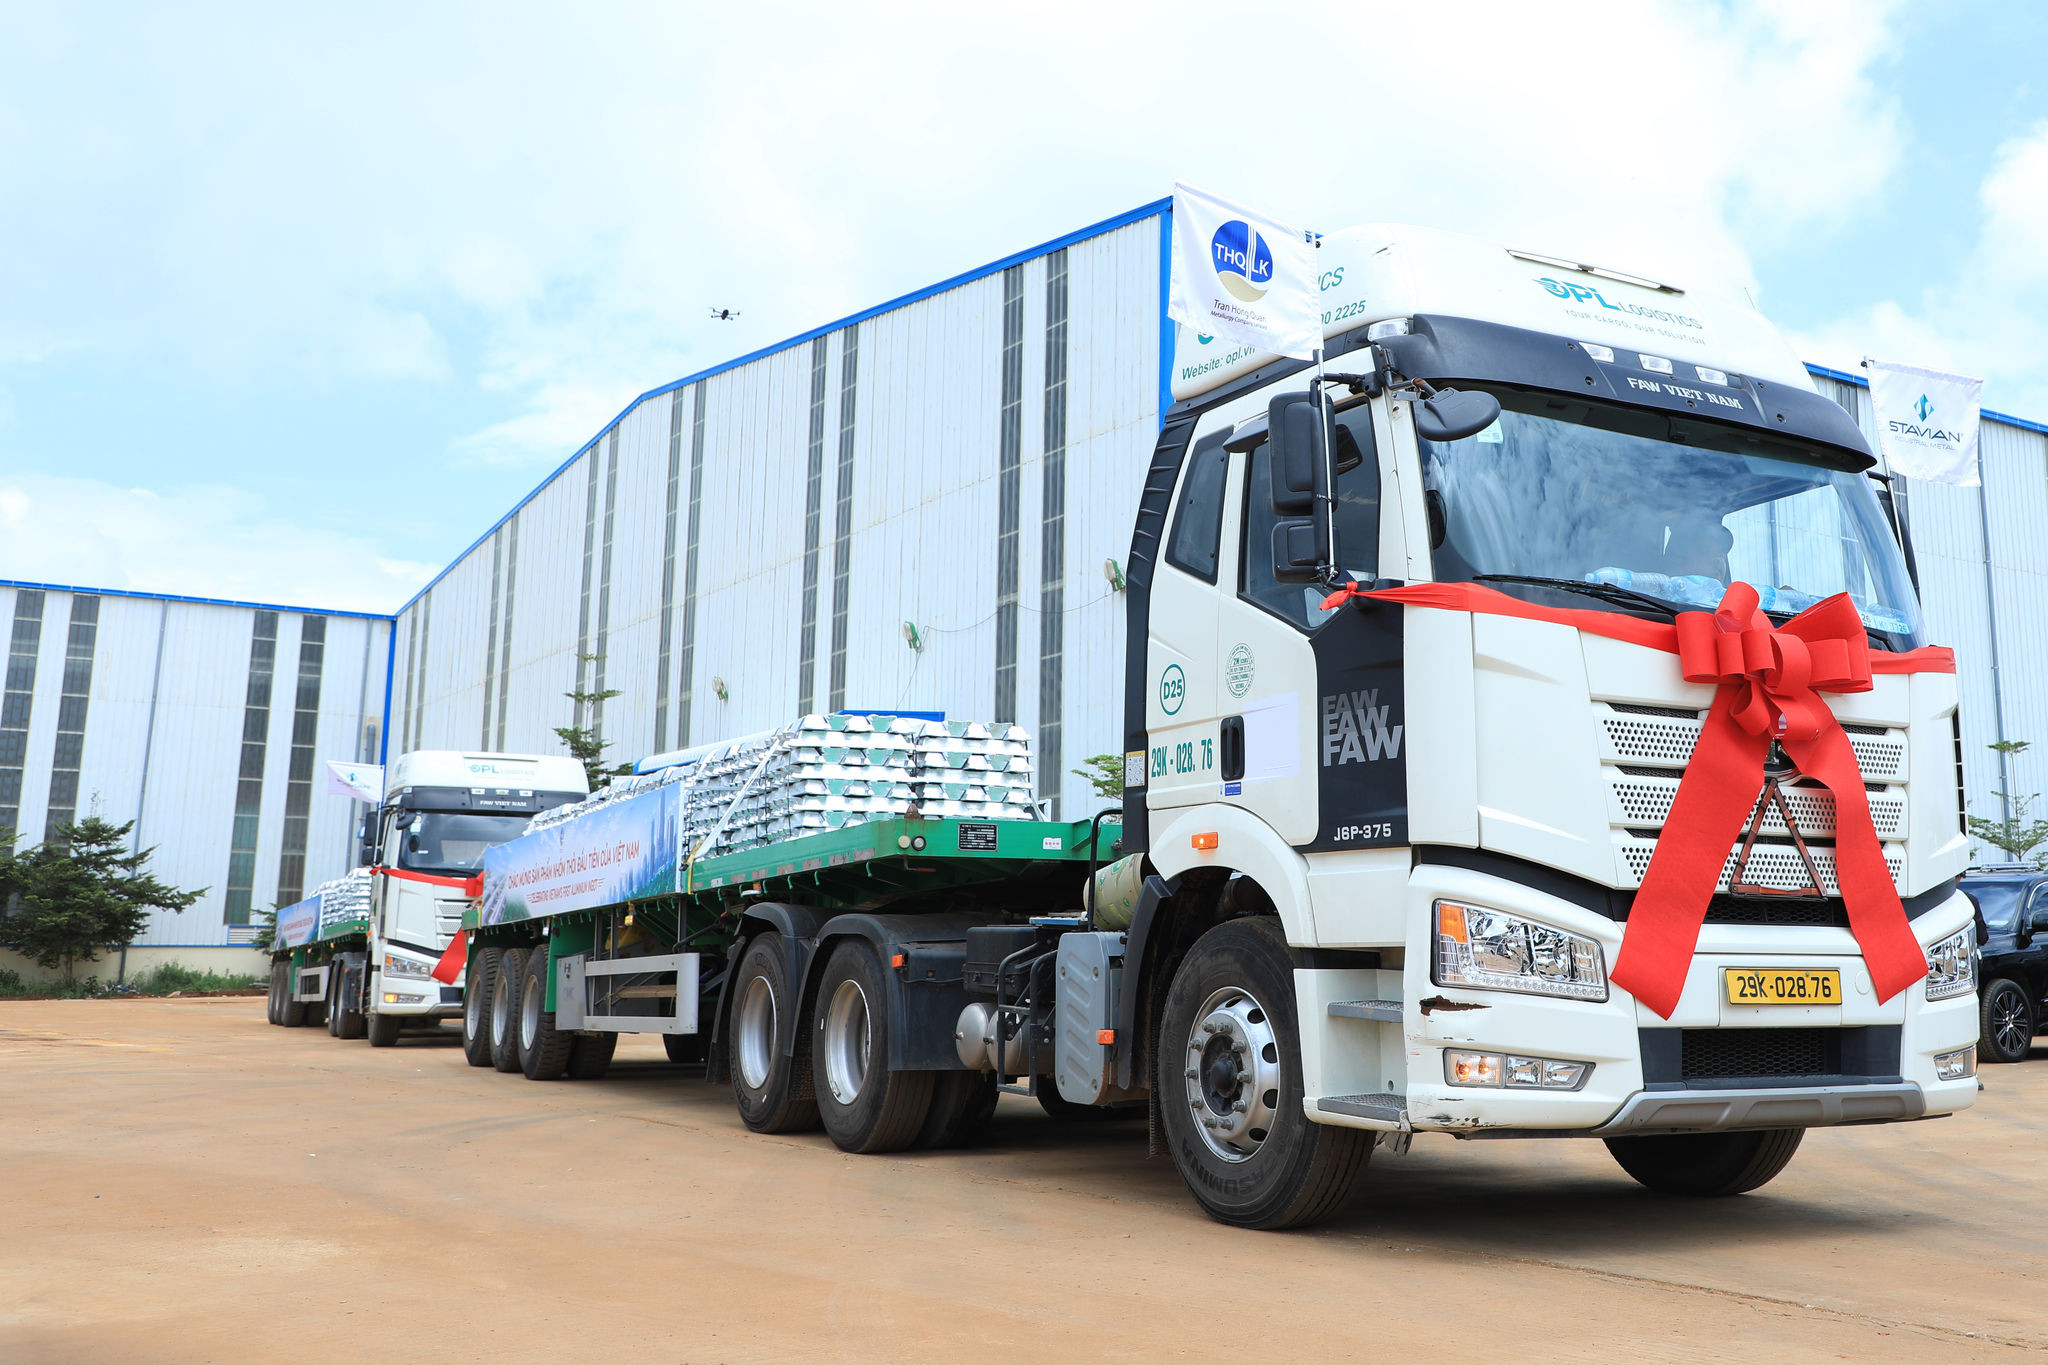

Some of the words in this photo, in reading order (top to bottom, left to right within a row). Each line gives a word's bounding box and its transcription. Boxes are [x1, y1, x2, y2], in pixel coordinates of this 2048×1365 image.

[1214, 299, 1230, 311] Tran
[1231, 304, 1249, 319] Hong
[1334, 300, 1366, 321] 2225
[1618, 302, 1702, 329] LOGISTICS
[1565, 309, 1591, 320] YOUR
[1634, 323, 1655, 334] OUR
[1657, 328, 1705, 345] SOLUTION
[1182, 357, 1223, 380] Website:
[1627, 377, 1661, 393] FAW
[1663, 383, 1703, 401] VIET
[1707, 391, 1744, 410] NAM
[1889, 420, 1960, 443] STAVIAN
[1163, 679, 1183, 700] D25
[1323, 688, 1378, 714] FAW
[1323, 705, 1389, 737] FAW
[1151, 747, 1167, 777] 29K
[1201, 738, 1213, 770] 76
[1323, 725, 1403, 767] FAW
[1333, 823, 1392, 841] J6P-375
[612, 840, 625, 867] VIỆT
[626, 840, 640, 860] NAM
[1736, 975, 1831, 998] 29K-028.76
